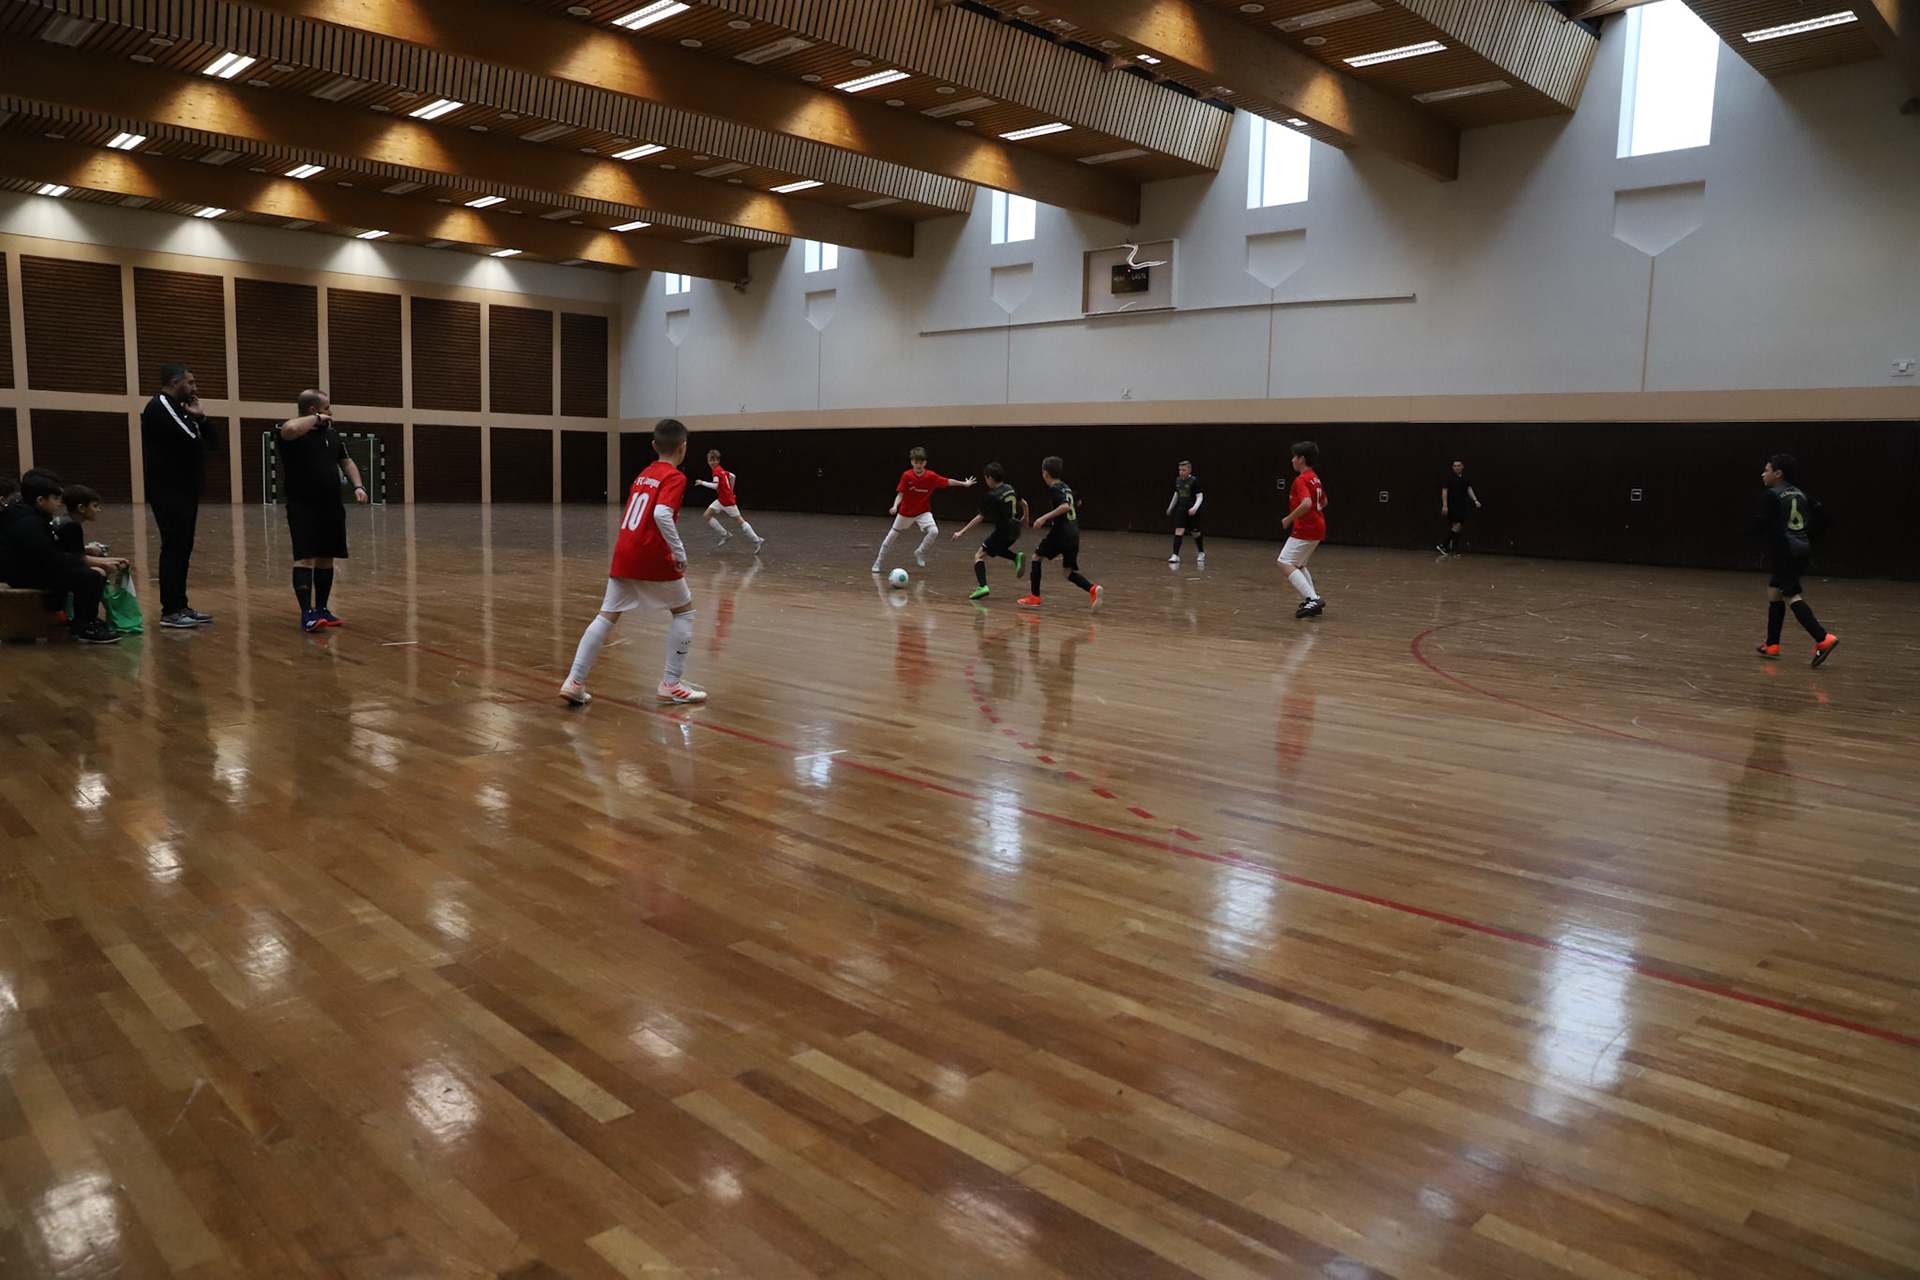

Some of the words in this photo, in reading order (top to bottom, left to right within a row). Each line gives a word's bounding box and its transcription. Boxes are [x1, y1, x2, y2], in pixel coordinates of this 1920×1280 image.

[621, 492, 650, 531] 10
[1004, 495, 1017, 517] 7
[1065, 493, 1077, 521] 3
[1787, 497, 1804, 531] 6
